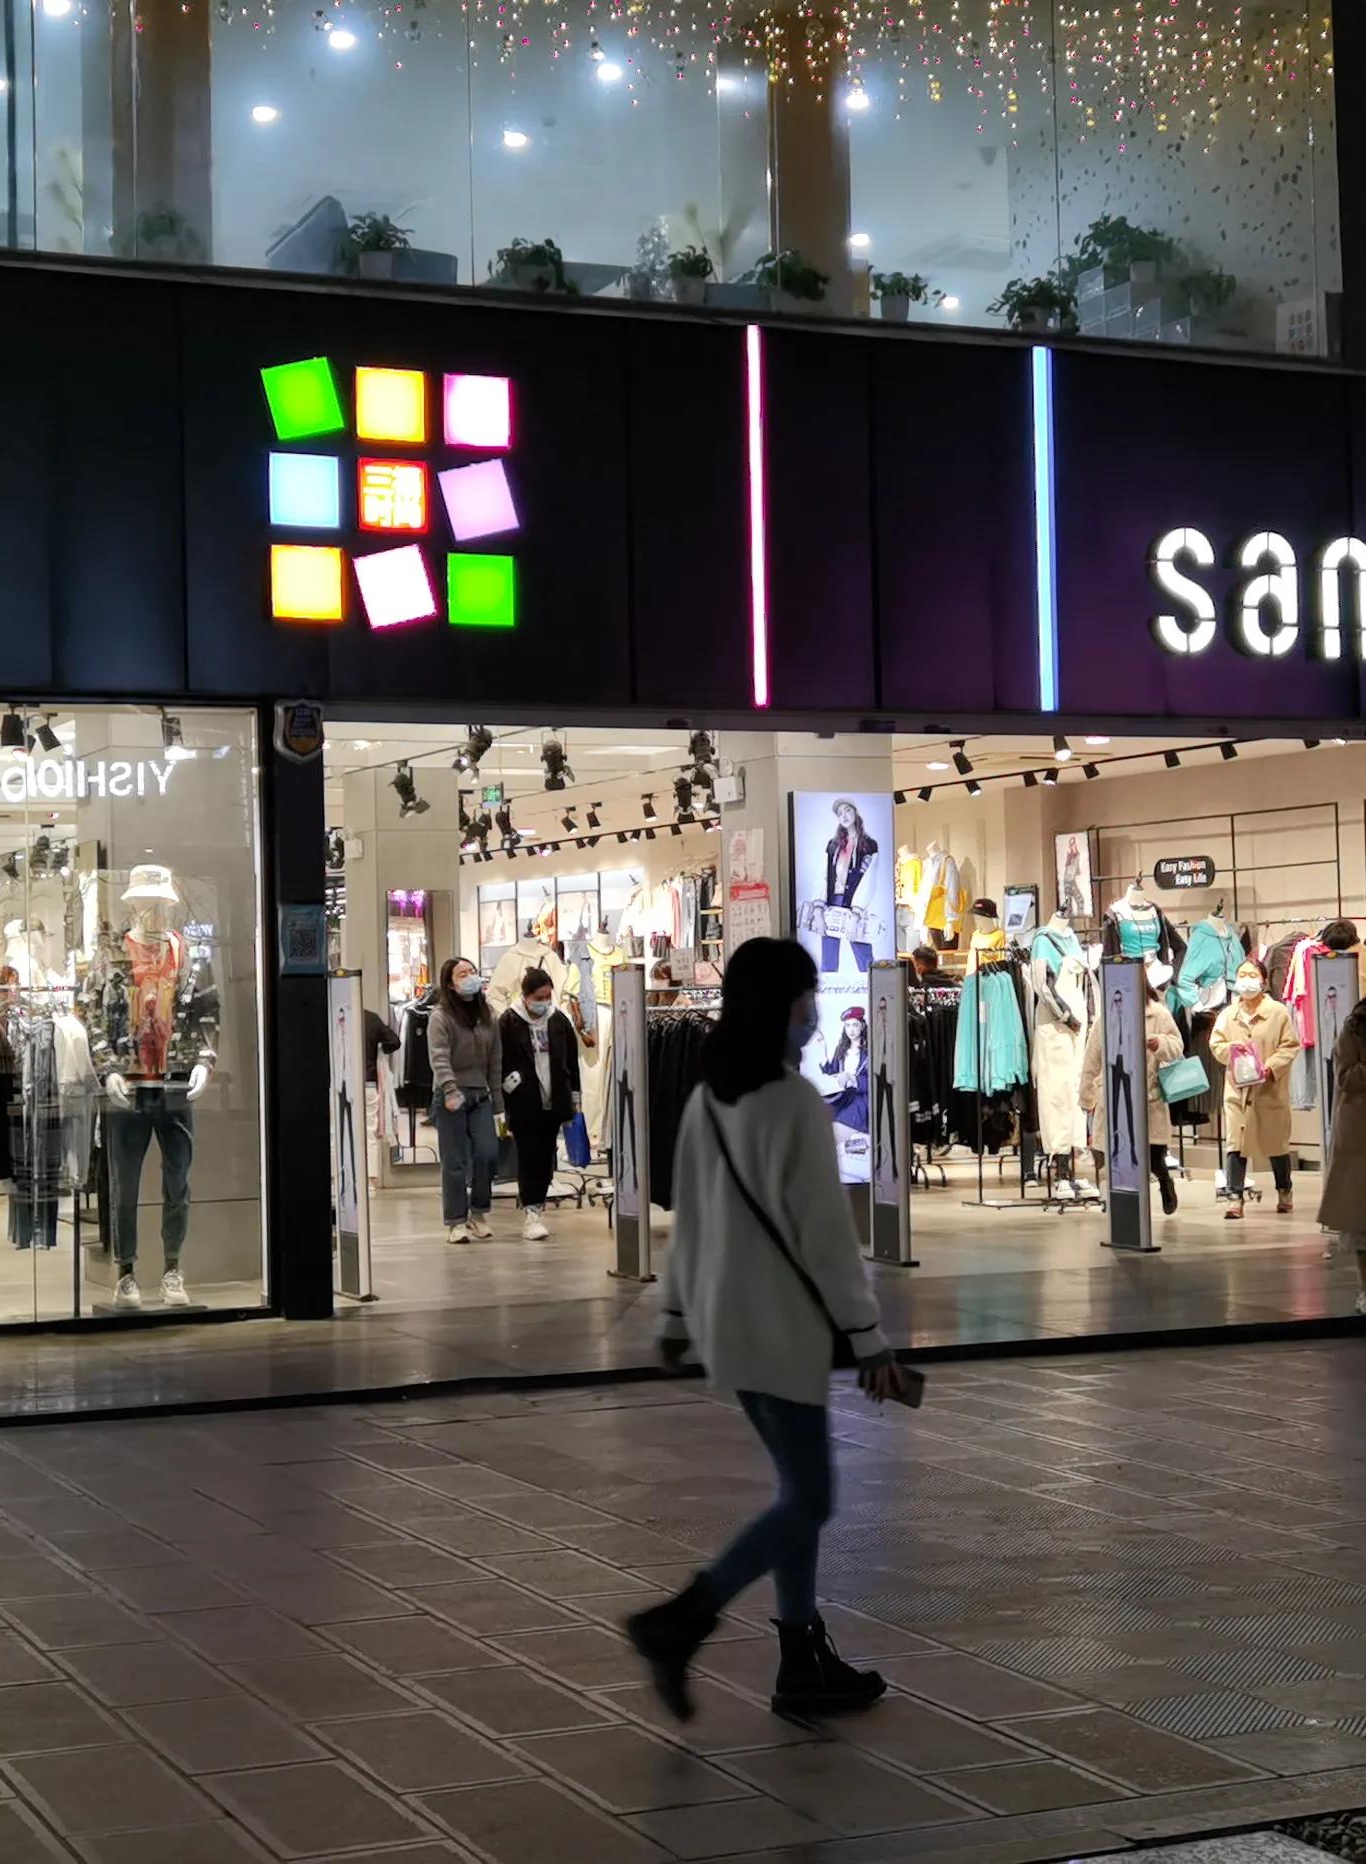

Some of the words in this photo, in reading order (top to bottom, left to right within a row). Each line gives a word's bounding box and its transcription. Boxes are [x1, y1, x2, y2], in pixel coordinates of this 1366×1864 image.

[1160, 861, 1177, 874] Easy
[1178, 860, 1206, 873] Fashion
[1175, 874, 1192, 886] Easy
[1193, 873, 1207, 884] Life
